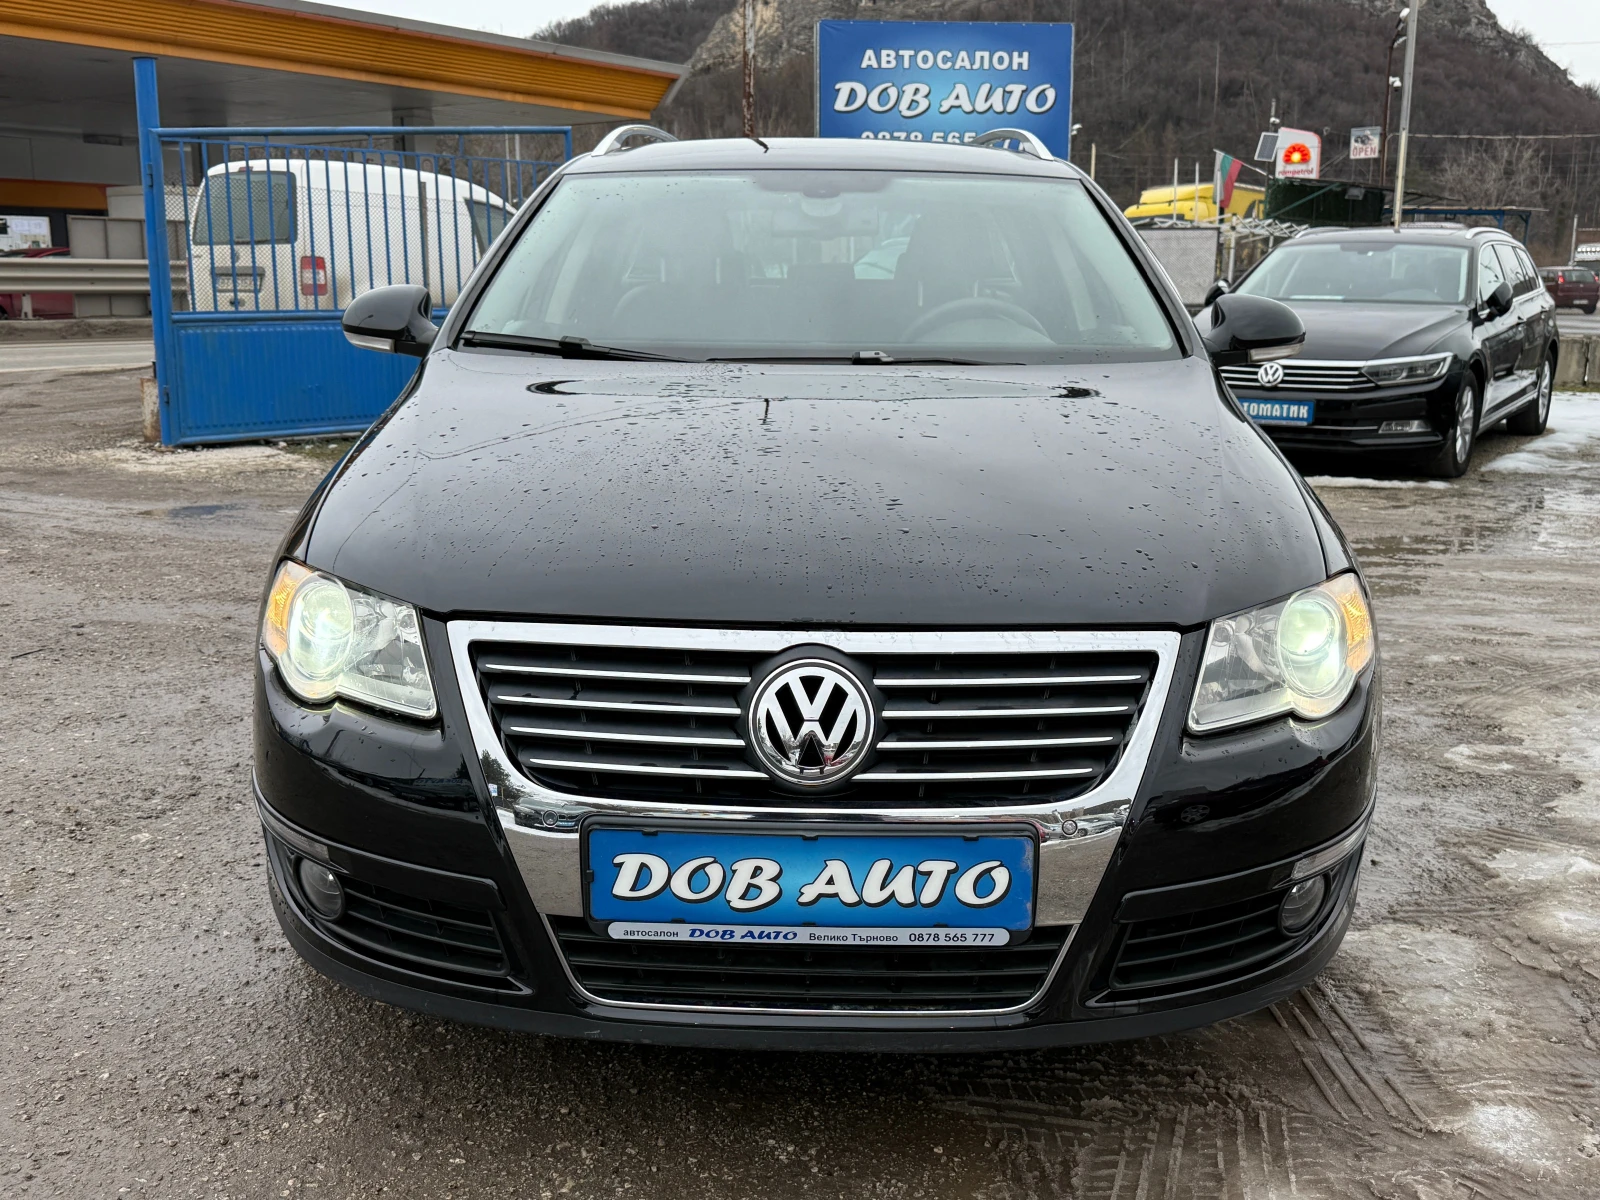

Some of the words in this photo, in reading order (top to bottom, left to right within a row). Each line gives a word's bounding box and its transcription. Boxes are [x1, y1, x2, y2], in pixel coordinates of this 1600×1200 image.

[861, 49, 1029, 70] АВТОСАЛОН
[833, 81, 931, 117] DOB
[938, 83, 1056, 114] AUTO
[1352, 146, 1377, 157] OPEN
[611, 852, 783, 912] DOB
[797, 858, 1013, 908] AUTO
[623, 929, 679, 938] автосалон
[688, 928, 736, 941] DOB
[740, 930, 798, 941] AUTO
[808, 932, 848, 942] Велико
[851, 933, 899, 944] Търново
[908, 932, 940, 943] 0878
[943, 932, 968, 943] 565
[972, 933, 995, 943] 777
